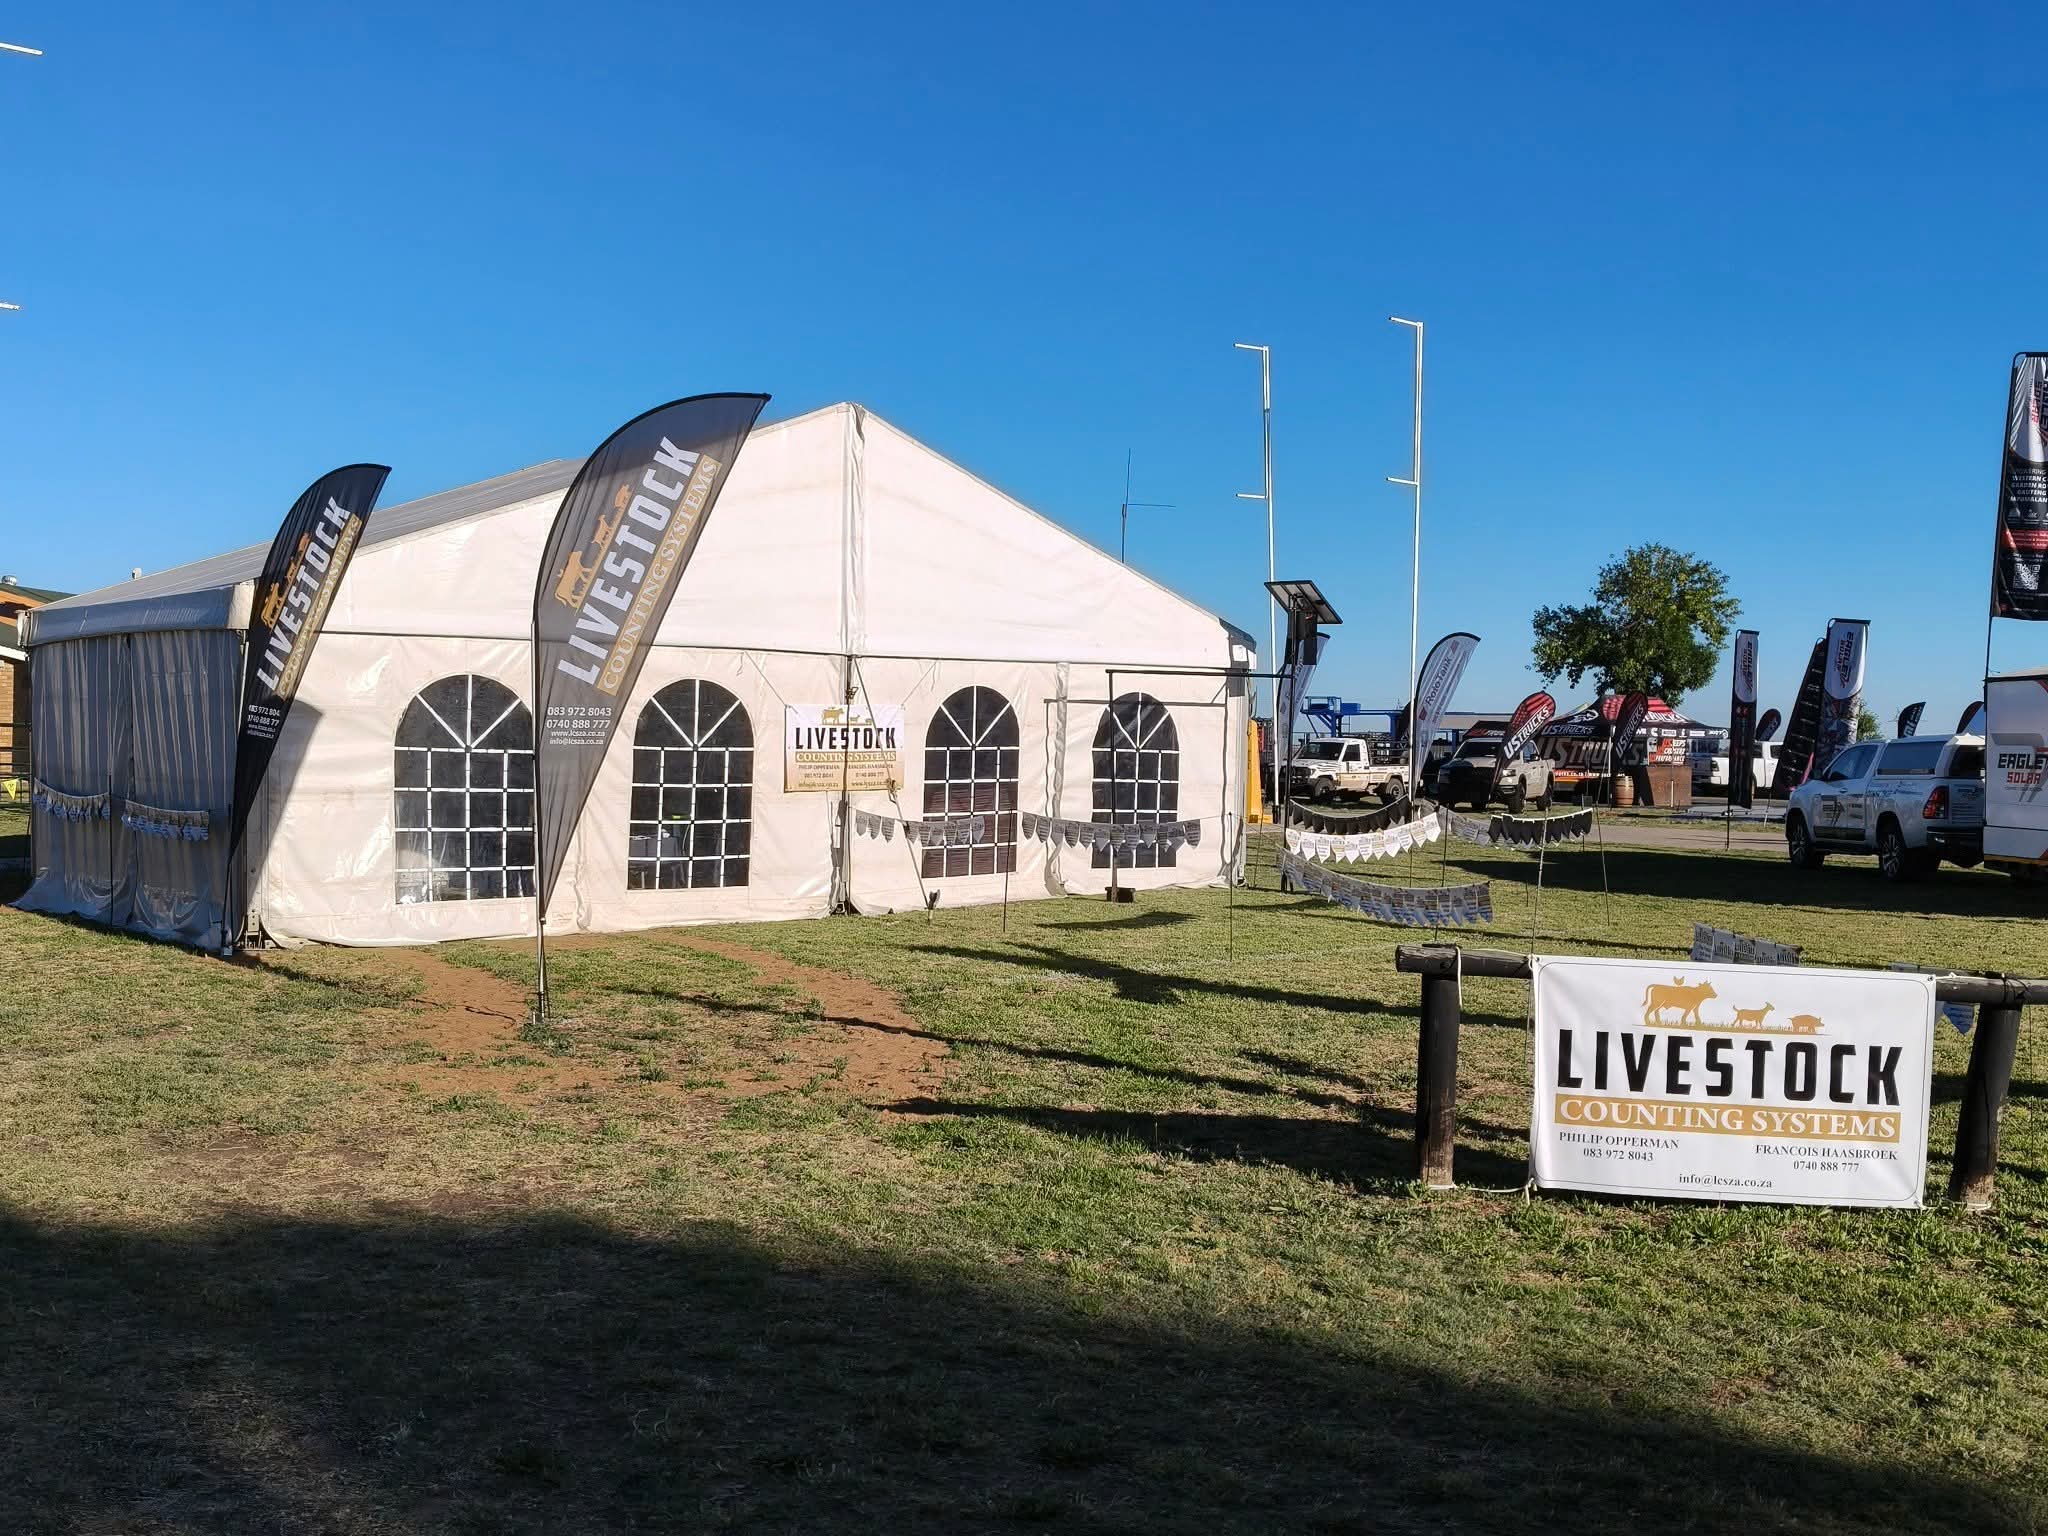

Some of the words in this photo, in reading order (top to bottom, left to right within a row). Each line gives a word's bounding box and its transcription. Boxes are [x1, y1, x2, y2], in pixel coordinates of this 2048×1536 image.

[557, 435, 700, 686] LIVESTOCK
[603, 563, 668, 690] COUNTING
[661, 460, 718, 561] SYSTEMS
[257, 496, 351, 691] LIVESTOCK
[1425, 657, 1452, 706] RotoTank
[268, 708, 280, 717] 804
[547, 706, 565, 716] 083
[568, 706, 586, 716] 972
[587, 707, 612, 717] 8043
[546, 719, 570, 729] 0740
[571, 720, 590, 729] 888
[592, 720, 611, 729] 777
[795, 727, 896, 750] LIVESTOCK
[1997, 753, 2043, 770] EAGLE
[2007, 771, 2041, 784] SOLAR
[1558, 1029, 1903, 1106] LIVESTOCK
[1560, 1099, 1744, 1131] COUNTING
[1751, 1110, 1895, 1139] SYSTEMS
[1559, 1131, 1603, 1145] PHILIP
[1605, 1135, 1680, 1149] OPPERMAN
[1583, 1148, 1602, 1158] 083
[1605, 1150, 1625, 1160] 972
[1628, 1151, 1653, 1161] 8043
[1755, 1144, 1819, 1157] FRANCOIS
[1821, 1147, 1898, 1161] HAASBROEK
[1793, 1160, 1817, 1171] 0740
[1820, 1161, 1838, 1172] 888
[1841, 1162, 1860, 1173] 777
[1679, 1173, 1772, 1189] info@lcsza.co.za
